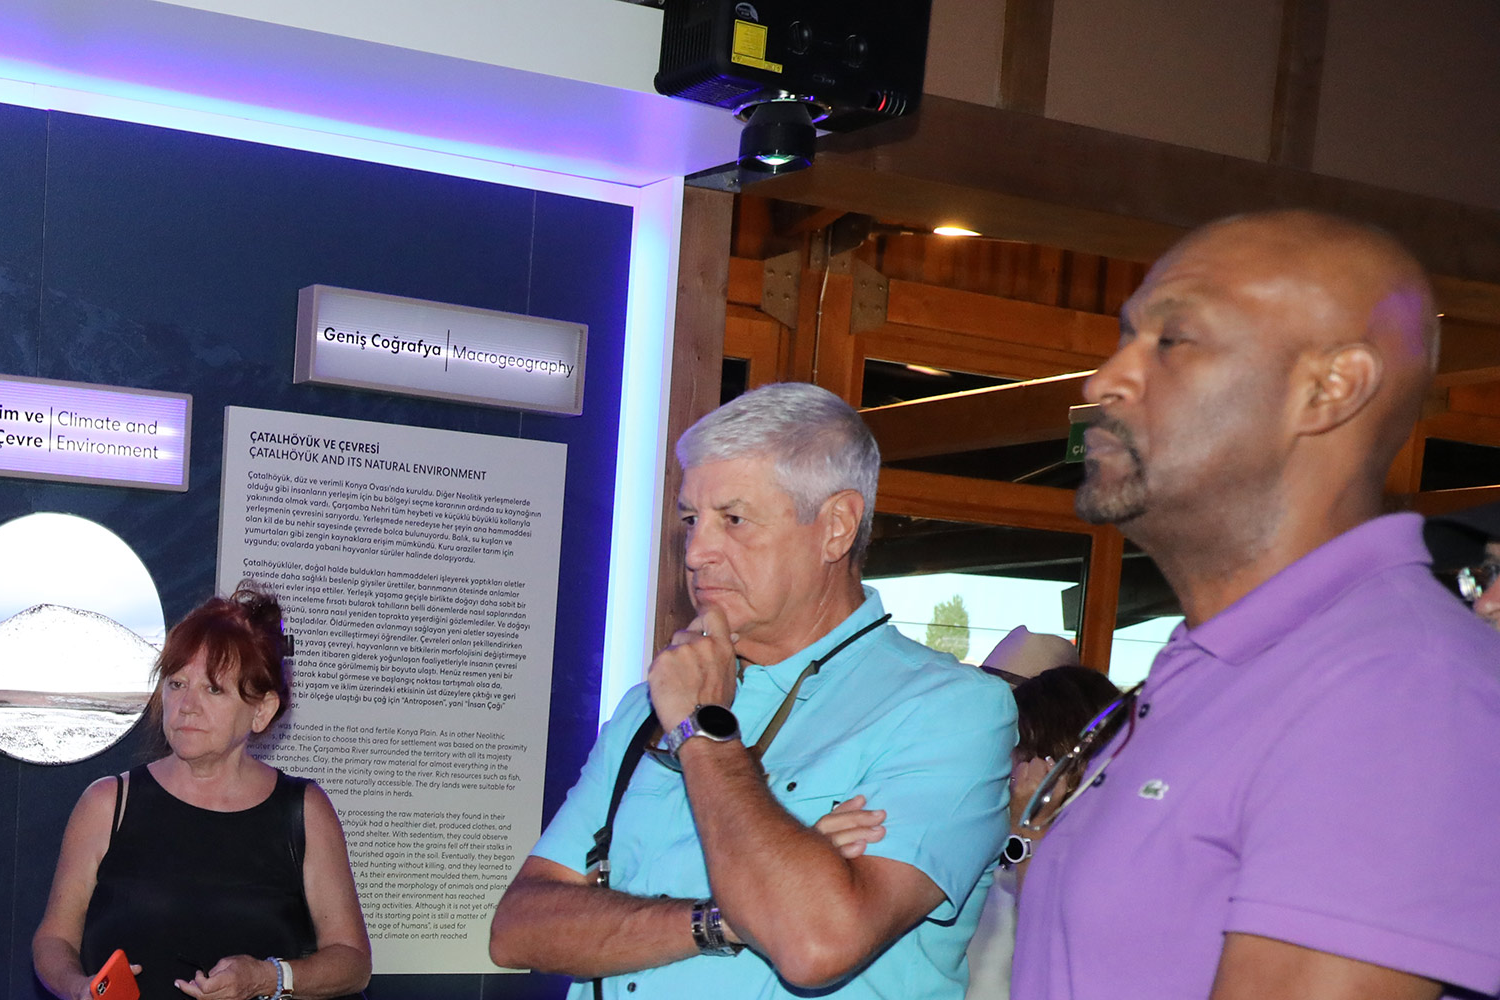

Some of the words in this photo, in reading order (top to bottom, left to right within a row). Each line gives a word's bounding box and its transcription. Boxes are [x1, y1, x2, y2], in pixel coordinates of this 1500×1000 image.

[323, 327, 367, 350] Geniş
[371, 333, 442, 358] Coğrafya
[452, 344, 575, 378] Macrogeography
[24, 410, 44, 423] ve
[57, 410, 122, 433] Climate
[126, 418, 159, 436] and
[57, 436, 159, 459] Environment
[250, 431, 320, 448] ÇATALHÖYÜK
[323, 439, 336, 450] VE
[339, 441, 380, 454] ÇEVRESİ
[249, 446, 319, 463] ÇATALHÖYÜK
[321, 454, 345, 466] AND
[348, 457, 362, 468] ITS
[365, 459, 410, 473] NATURAL
[413, 464, 487, 480] ENVIRONMENT
[279, 732, 291, 741] the
[292, 734, 322, 742] decision
[332, 736, 357, 744] choose
[497, 744, 527, 753] proximity
[294, 723, 324, 732] founded
[347, 725, 358, 733] flat
[376, 727, 395, 735] fertile
[397, 728, 418, 738] Konya
[420, 728, 438, 737] Plain.
[476, 732, 505, 740] Neolithic
[348, 810, 385, 819] processing
[446, 812, 461, 821] they
